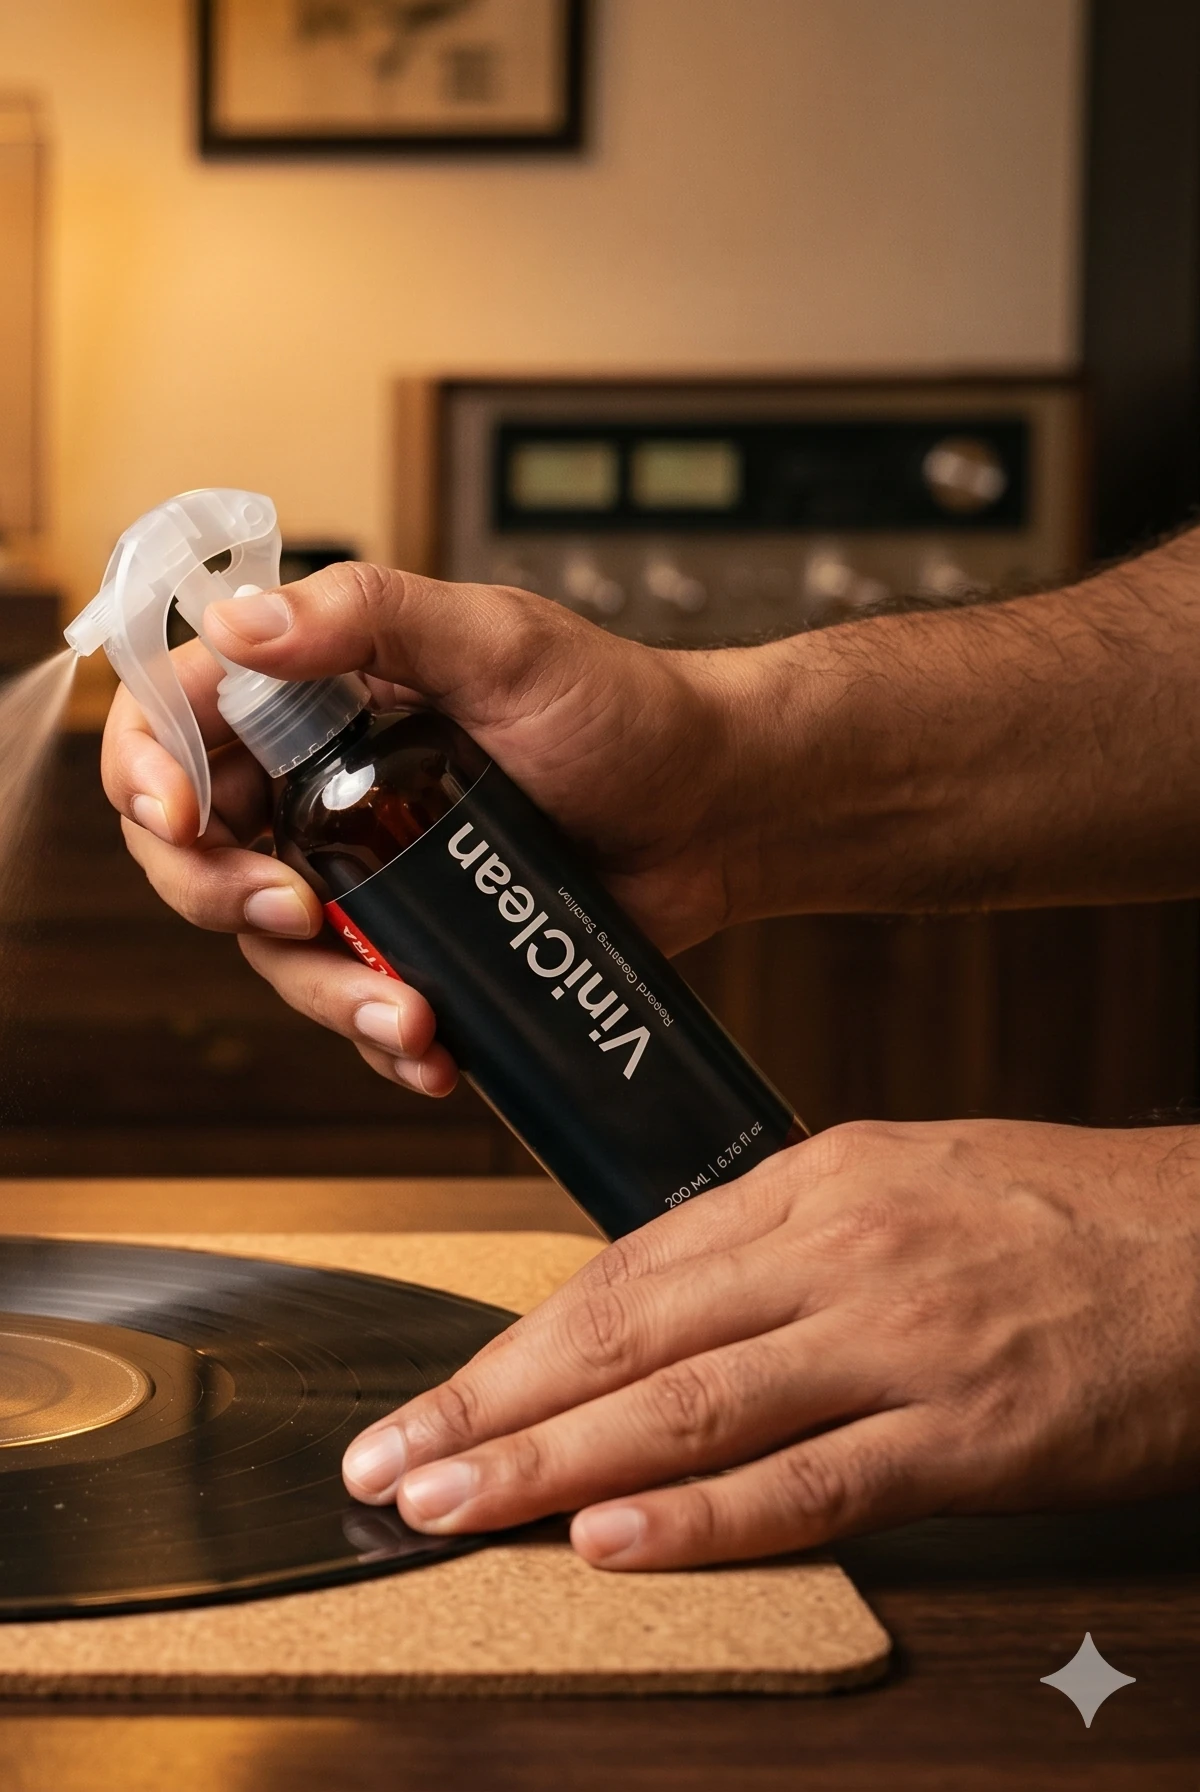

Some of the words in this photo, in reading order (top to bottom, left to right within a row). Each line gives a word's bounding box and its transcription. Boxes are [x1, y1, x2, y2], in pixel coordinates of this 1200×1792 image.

[447, 822, 650, 1080] ViniClean
[664, 1186, 691, 1208] 200
[690, 1173, 711, 1191] ML
[716, 1142, 742, 1169] 6.76
[739, 1131, 752, 1147] fl
[750, 1121, 763, 1136] oz
